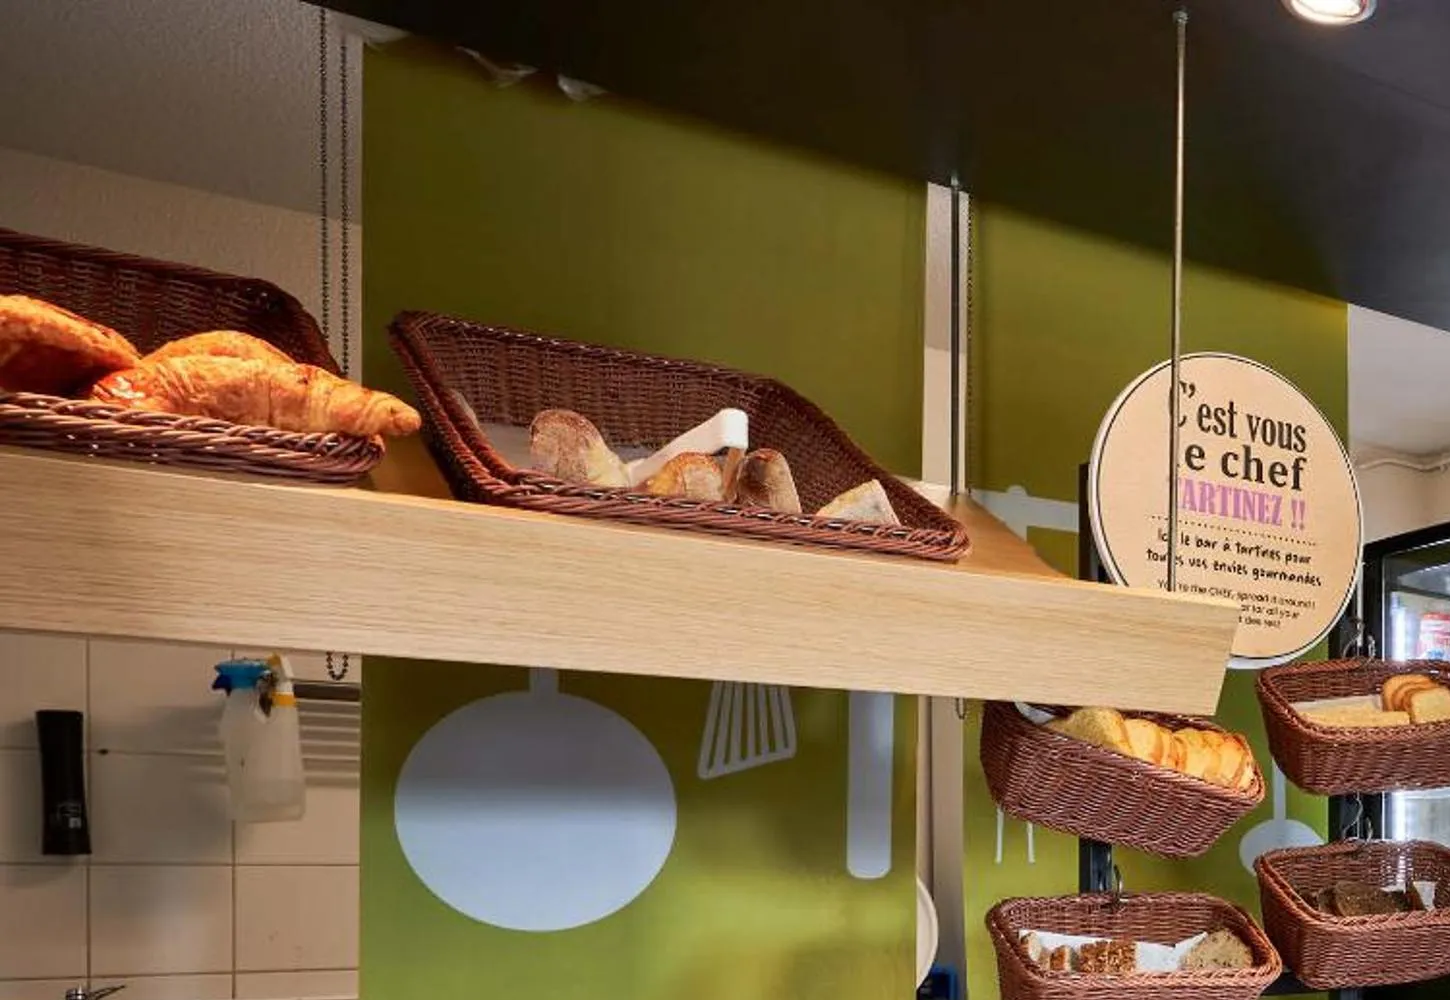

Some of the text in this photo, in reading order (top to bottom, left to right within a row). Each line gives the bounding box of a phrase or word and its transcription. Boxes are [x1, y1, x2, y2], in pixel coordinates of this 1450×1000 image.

[1246, 413, 1307, 454] vous
[1220, 444, 1308, 492] chef
[1178, 476, 1284, 527] ARTINEZ
[1180, 531, 1191, 546] le
[1195, 535, 1218, 551] bar
[1285, 554, 1313, 566] pour
[1188, 559, 1208, 570] vos
[1213, 559, 1249, 576] envies
[1252, 567, 1323, 588] gourmandes
